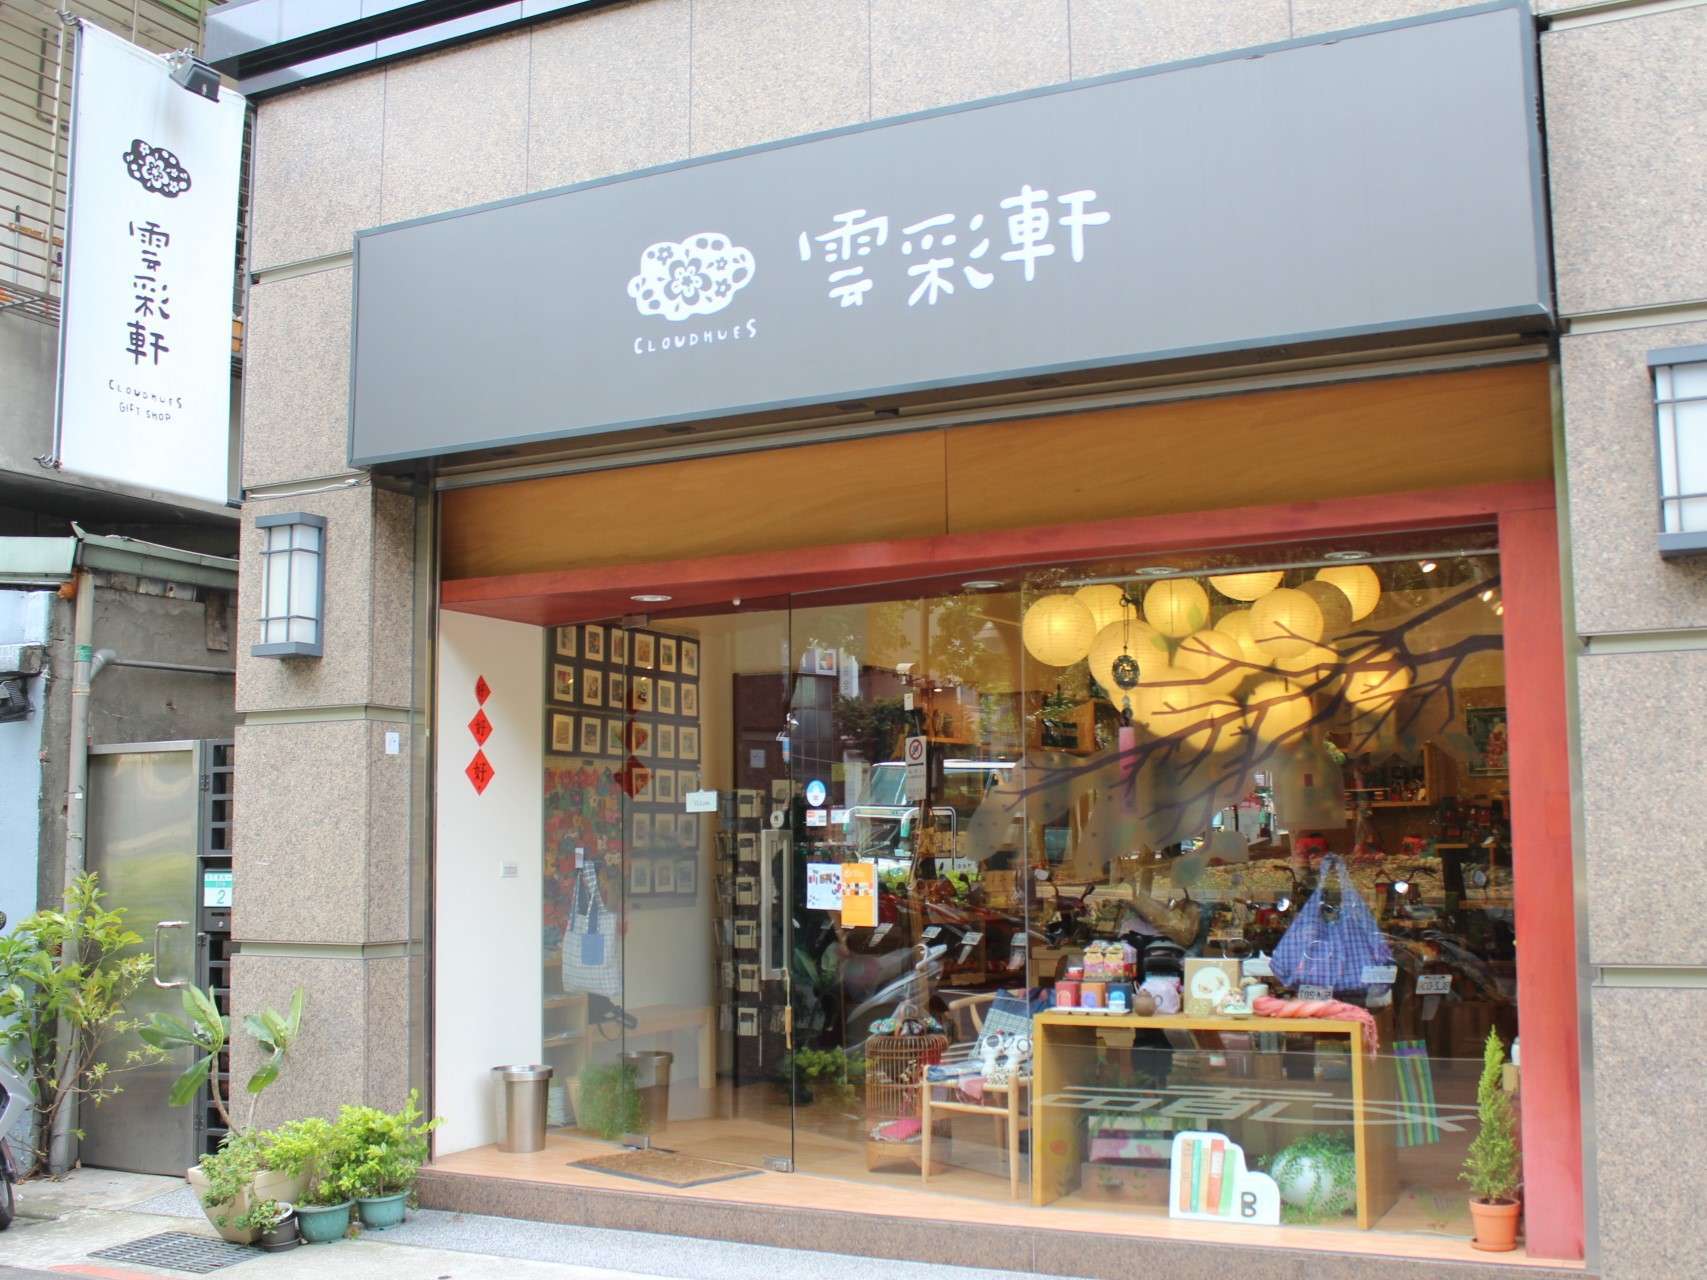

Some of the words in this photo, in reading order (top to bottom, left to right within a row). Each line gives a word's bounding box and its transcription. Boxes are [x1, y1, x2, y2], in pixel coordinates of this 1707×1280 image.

[799, 184, 1111, 308] 雲彩軒
[126, 220, 170, 366] 雲彩軒
[634, 318, 758, 354] CLOUDHUES
[215, 889, 226, 905] 2
[1240, 1191, 1257, 1218] B
